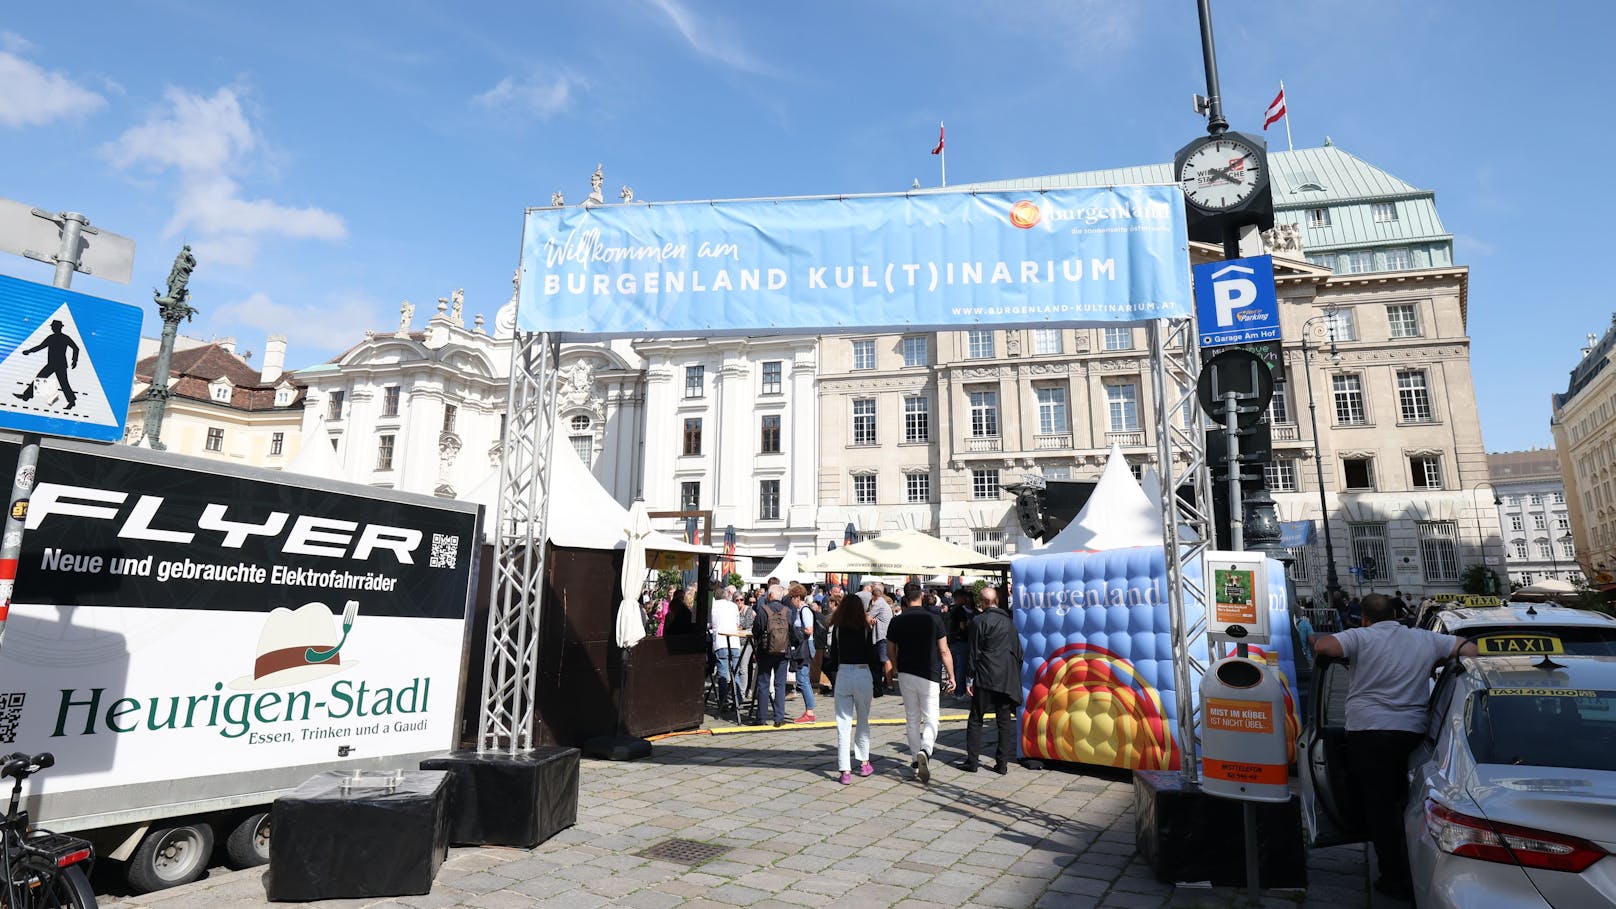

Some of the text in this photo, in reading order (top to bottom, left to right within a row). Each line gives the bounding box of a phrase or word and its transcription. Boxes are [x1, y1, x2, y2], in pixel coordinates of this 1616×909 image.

[544, 212, 740, 270] Willkommen am
[544, 258, 1117, 296] BURGENLAND KUL(T)INARIUM
[952, 302, 1177, 315] WWW.BURGENLAND-KULTINARIUM.AT
[1213, 278, 1257, 327] P
[1214, 334, 1242, 343] Garage
[1261, 330, 1276, 338] Hof
[24, 482, 423, 565] FLYER
[41, 547, 397, 592] Neue und gebrauchte Elektrofahrräder
[1019, 578, 1161, 616] burgenland
[1494, 639, 1545, 651] TAXI
[49, 677, 430, 738] Heurigen-Stadl
[1210, 708, 1267, 720] MIST IM KÜBEL
[1211, 717, 1221, 725] IST
[1222, 718, 1243, 727] NICHT
[249, 719, 428, 745] Essen, Trinken und a Gaudi
